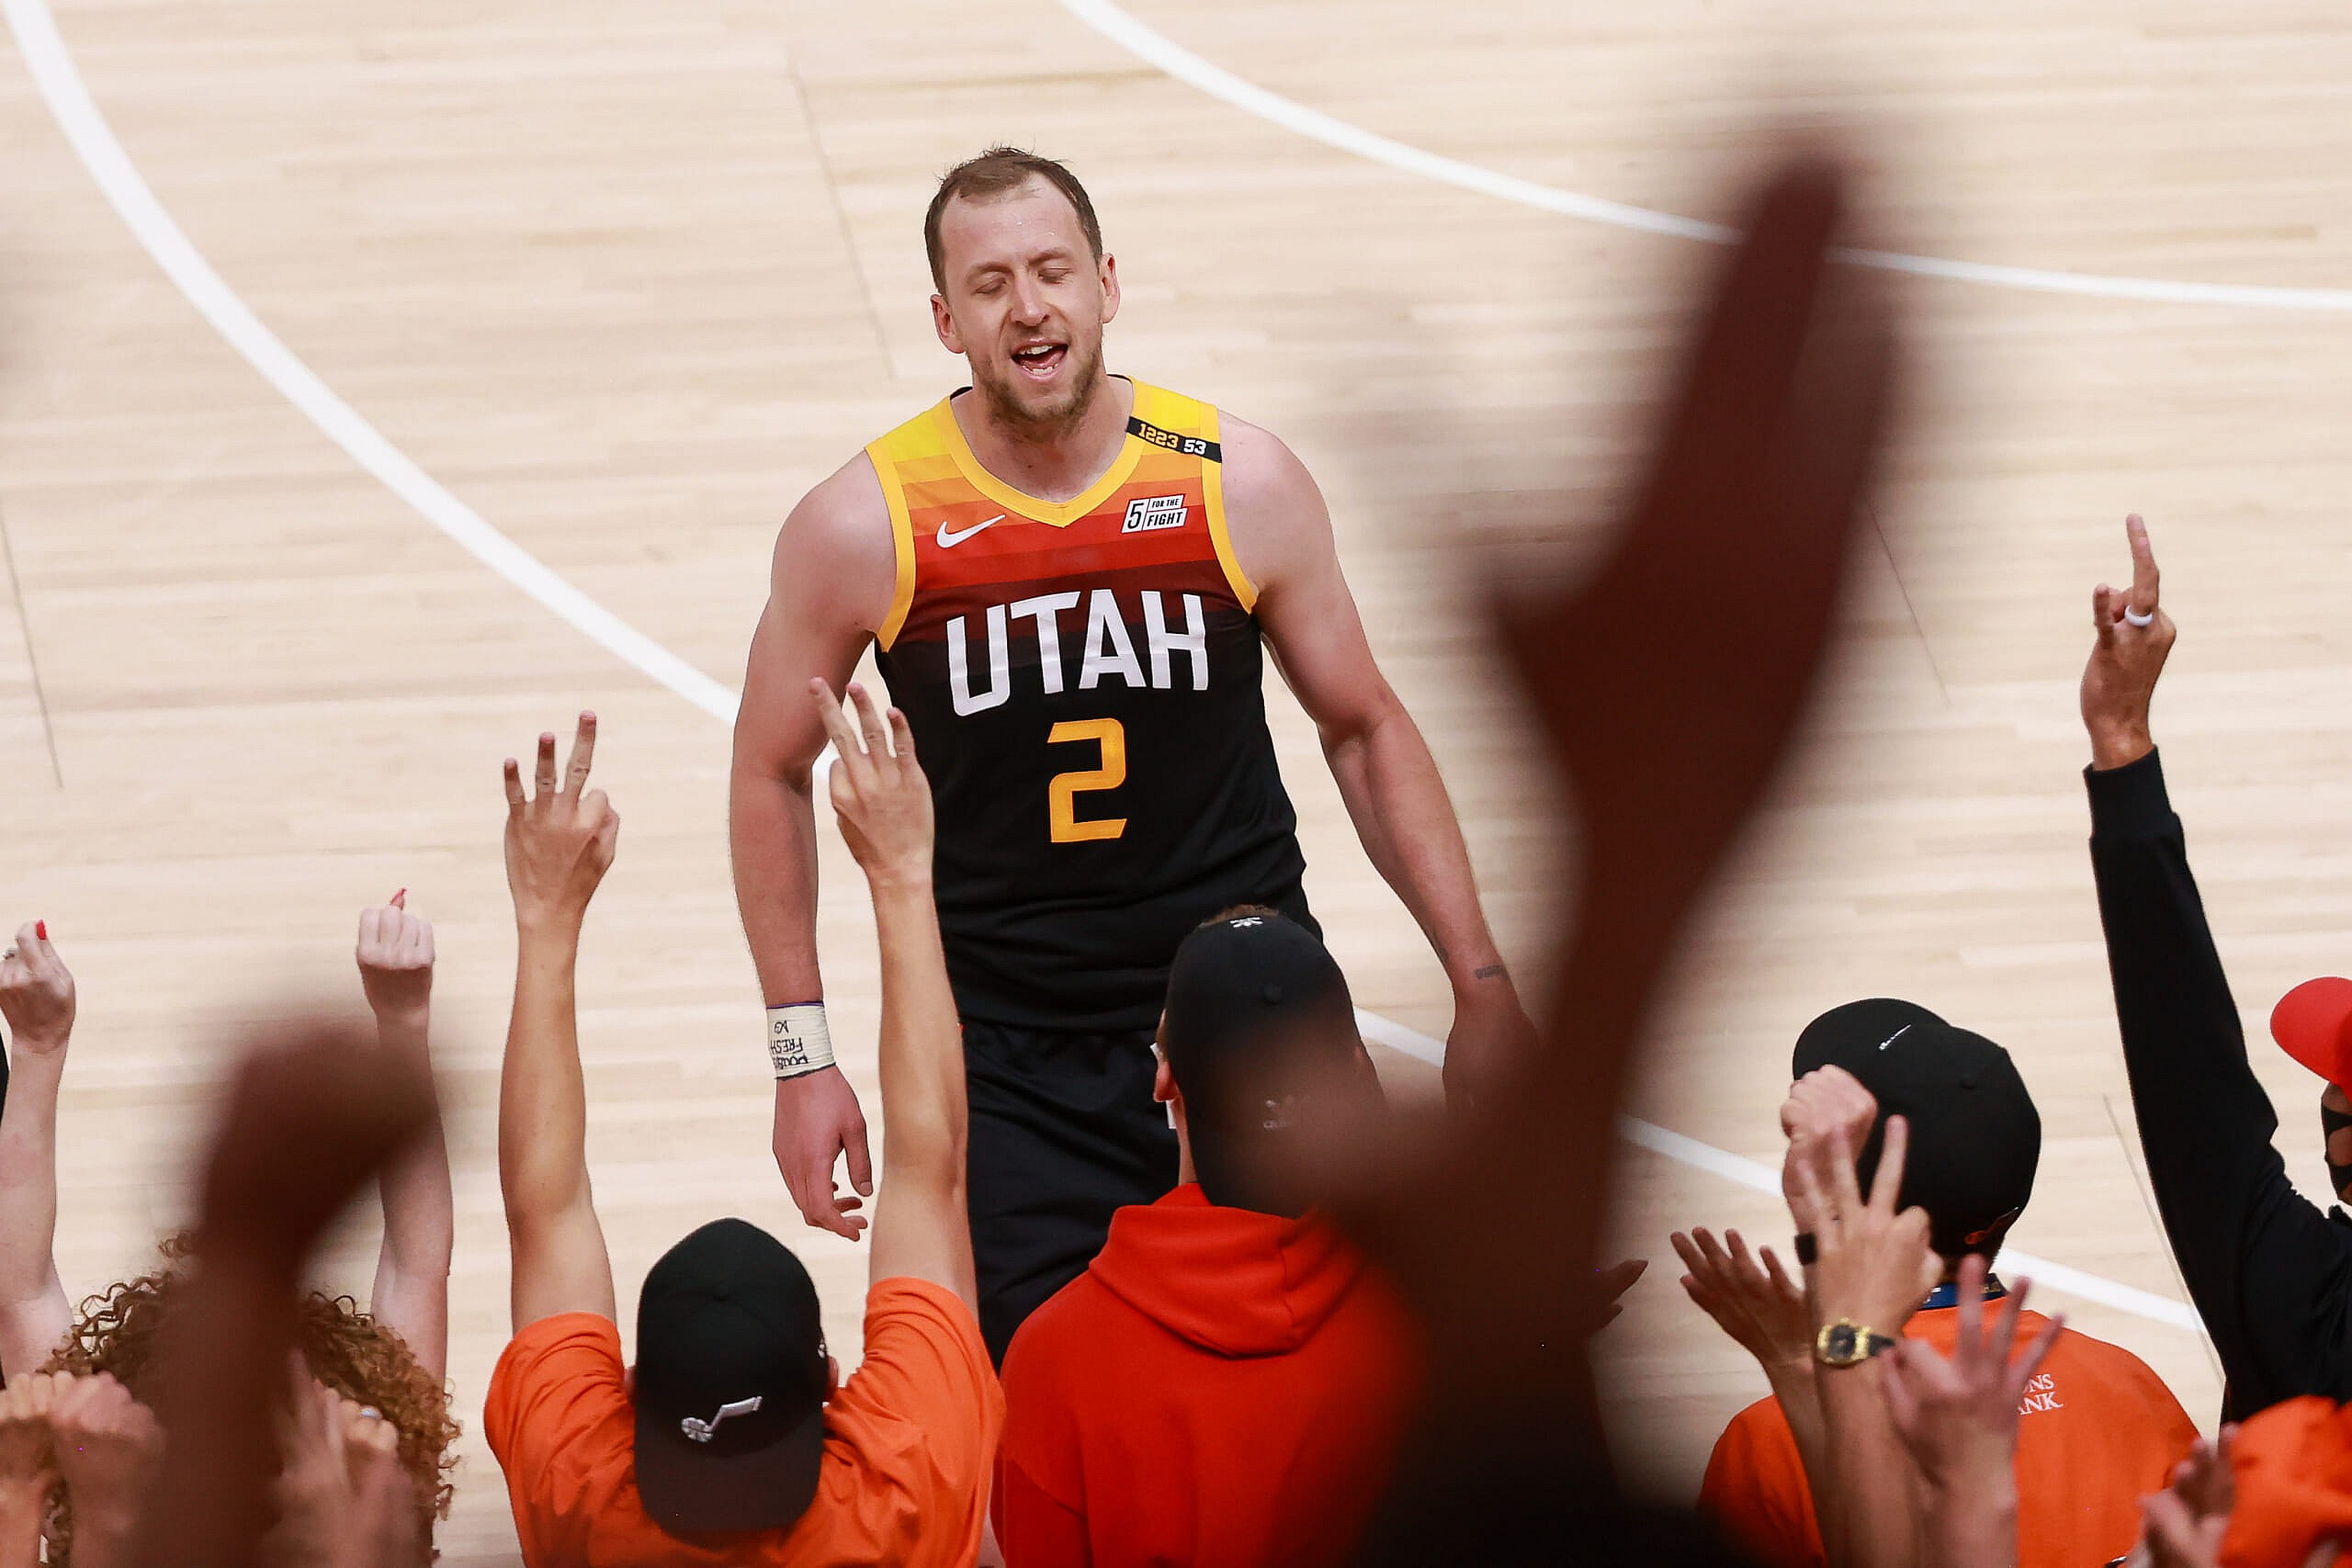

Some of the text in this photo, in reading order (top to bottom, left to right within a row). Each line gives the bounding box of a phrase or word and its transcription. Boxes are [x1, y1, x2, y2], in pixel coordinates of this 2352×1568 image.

[1138, 423, 1207, 456] 1223 53
[1126, 502, 1145, 529] 5
[1151, 498, 1180, 508] FOR THE
[1147, 511, 1183, 527] FIGHT
[945, 588, 1209, 717] UTAH
[1046, 717, 1128, 843] 2
[2022, 1373, 2054, 1394] NS
